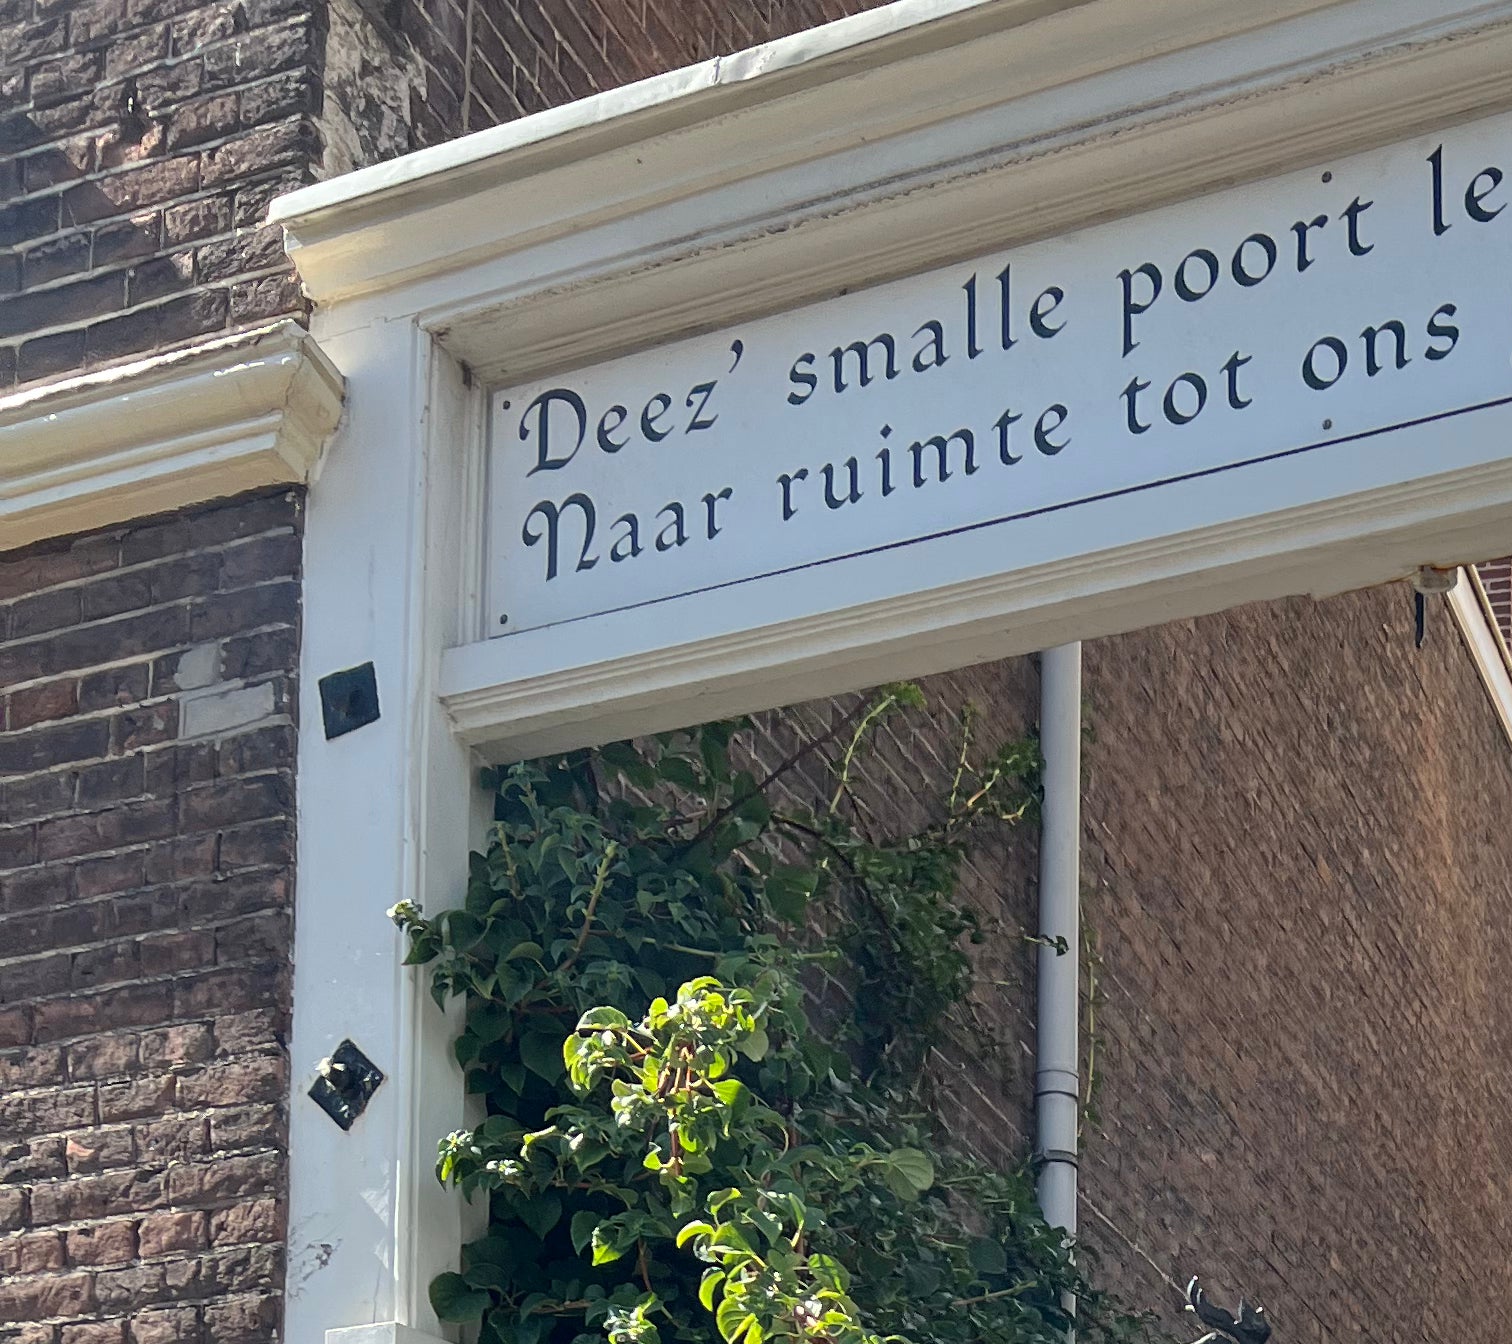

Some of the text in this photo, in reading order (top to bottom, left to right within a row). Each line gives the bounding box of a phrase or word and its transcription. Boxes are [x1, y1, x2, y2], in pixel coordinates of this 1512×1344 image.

[786, 263, 1066, 406] smalle
[1117, 197, 1375, 357] poort
[522, 486, 734, 581] Naar
[776, 404, 1071, 522] ruimte
[1120, 351, 1253, 435] tot
[1302, 303, 1460, 391] ons
